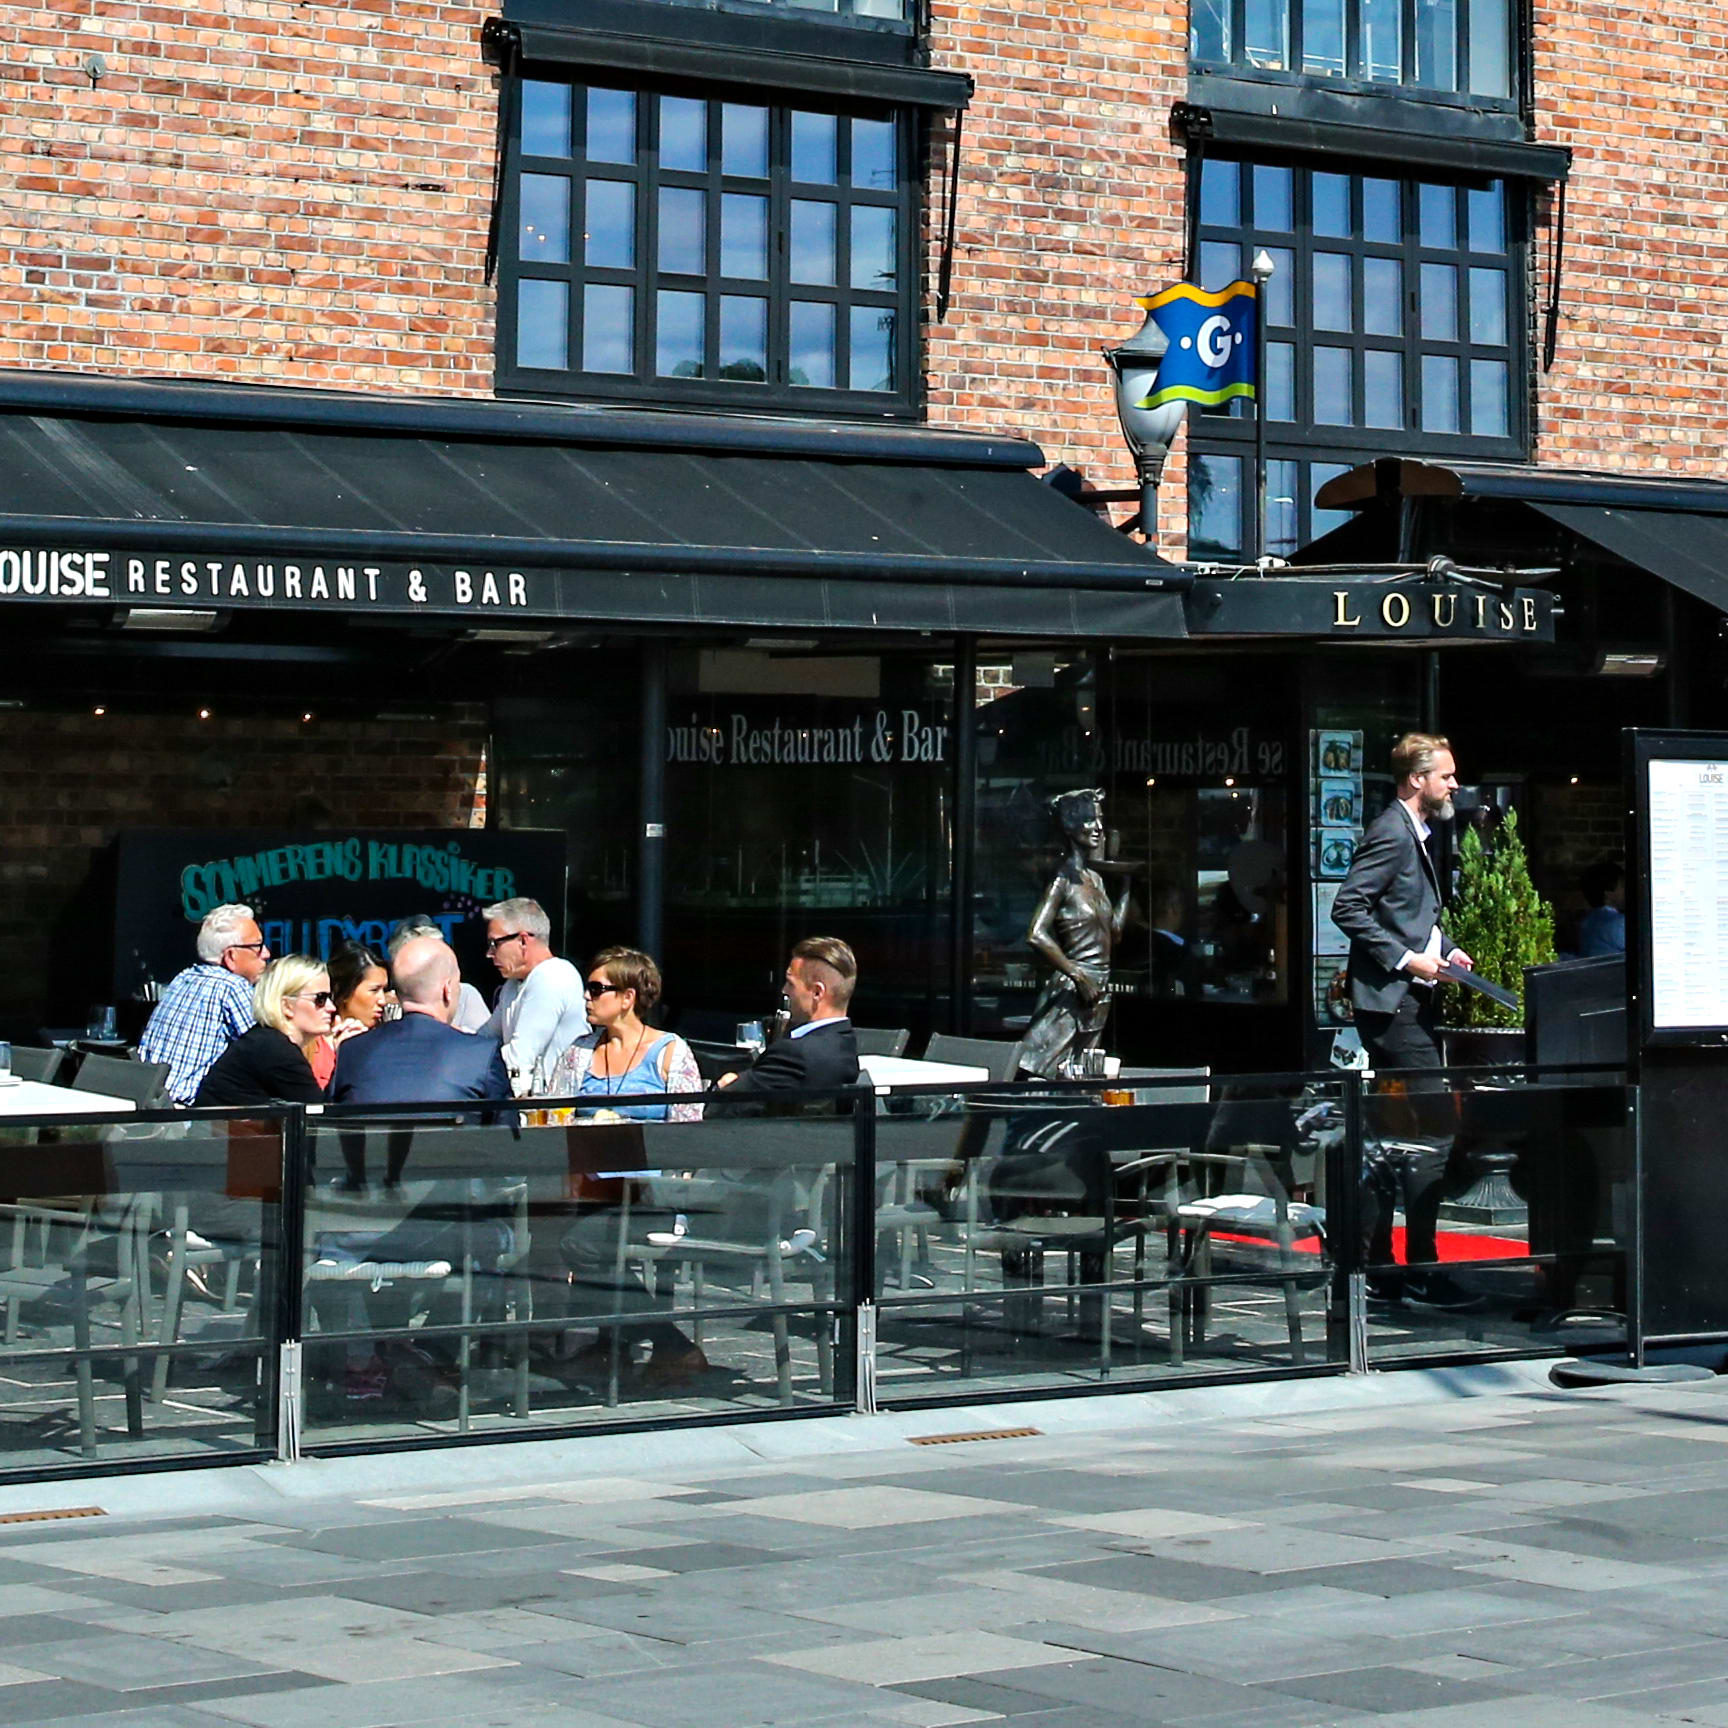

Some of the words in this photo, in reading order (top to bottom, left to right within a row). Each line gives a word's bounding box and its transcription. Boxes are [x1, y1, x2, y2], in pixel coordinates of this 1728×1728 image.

[127, 559, 381, 601] RESTAURANT
[407, 569, 428, 602] &
[455, 570, 529, 606] BAR
[1333, 591, 1537, 631] LOUISE
[666, 712, 724, 765] uise
[729, 713, 864, 764] Restaurant
[872, 709, 894, 763] &
[901, 710, 949, 762] Bar
[1699, 773, 1724, 784] LOUISE
[180, 837, 362, 922] SOMMERENS
[368, 840, 518, 901] KLASSIKER
